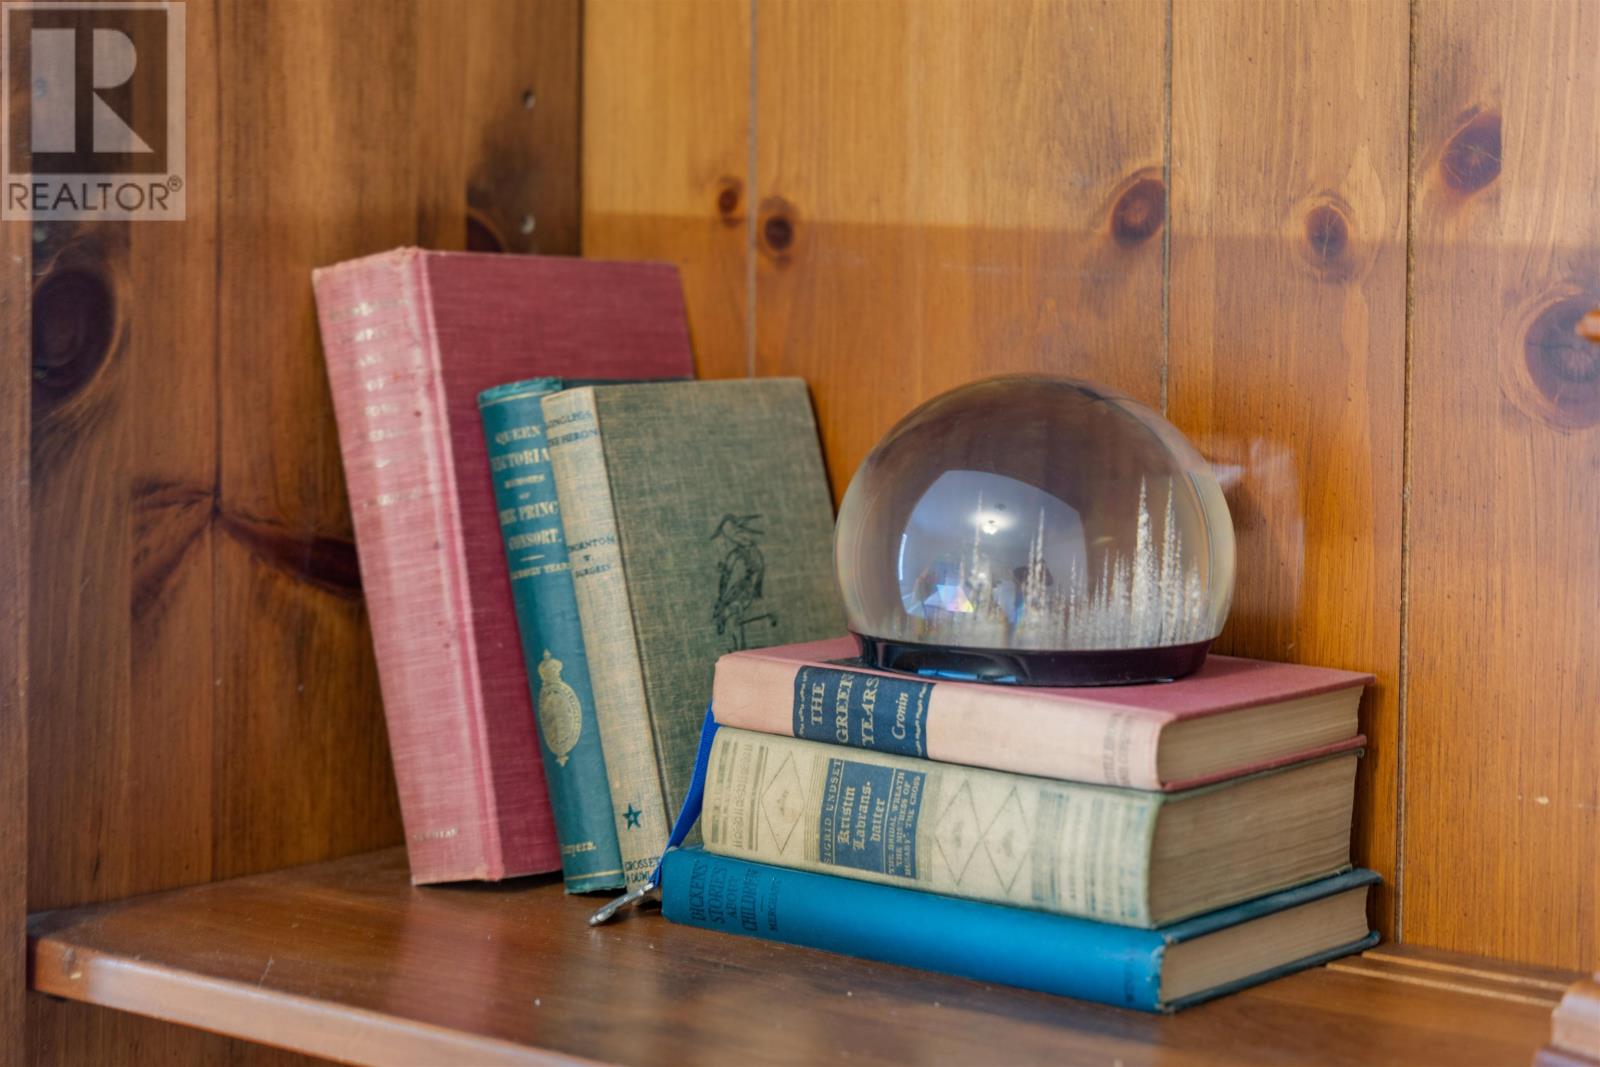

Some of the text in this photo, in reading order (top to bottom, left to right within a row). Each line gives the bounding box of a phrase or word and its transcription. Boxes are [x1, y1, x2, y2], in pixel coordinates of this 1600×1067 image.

[495, 425, 541, 446] QUEEN
[811, 682, 825, 725] THE
[862, 677, 881, 747] YEARS
[891, 692, 909, 740] Cronin
[903, 781, 911, 795] OF
[838, 787, 856, 845] Kristin
[823, 818, 833, 865] SIGRID
